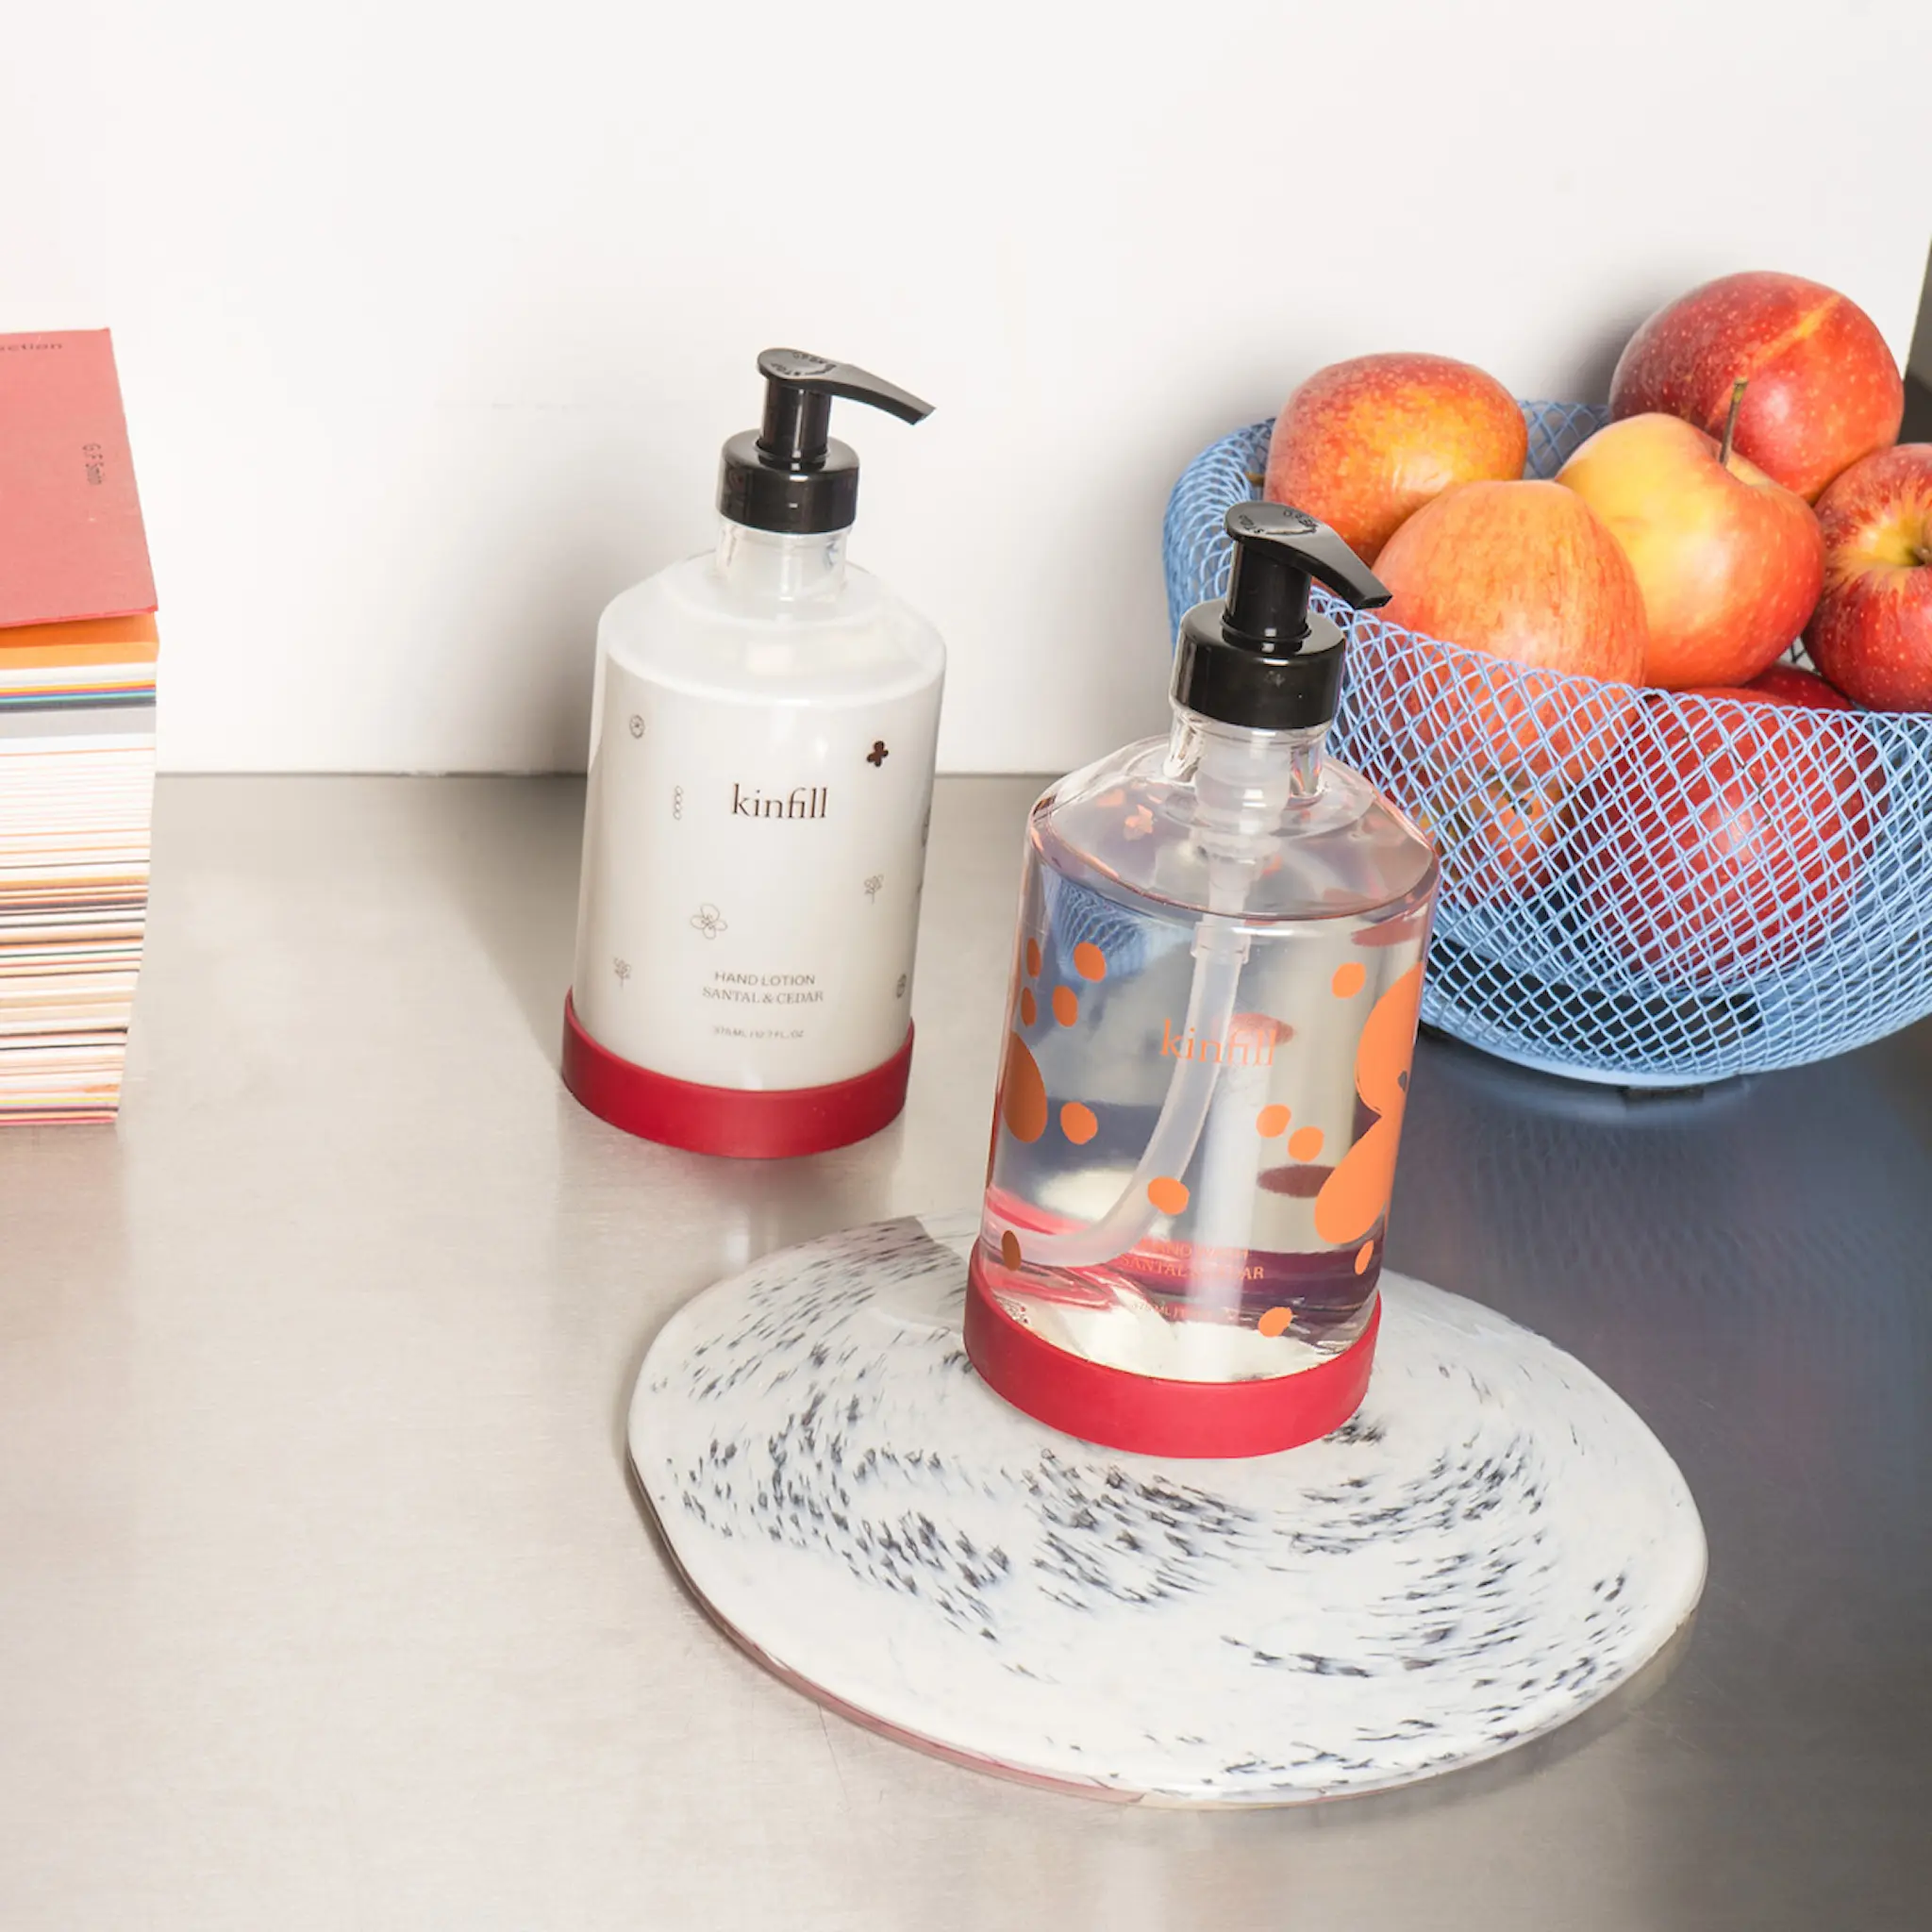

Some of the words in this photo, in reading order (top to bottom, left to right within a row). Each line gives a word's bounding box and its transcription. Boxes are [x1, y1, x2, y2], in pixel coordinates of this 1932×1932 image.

[731, 782, 828, 820] kinfill
[715, 971, 758, 986] HAND
[760, 974, 815, 987] LOTION
[702, 987, 760, 1003] SANTAL
[762, 991, 774, 1004] &
[776, 991, 824, 1005] CEDAR
[1159, 1018, 1276, 1067] kinfill
[1123, 1255, 1187, 1277] SANTAL
